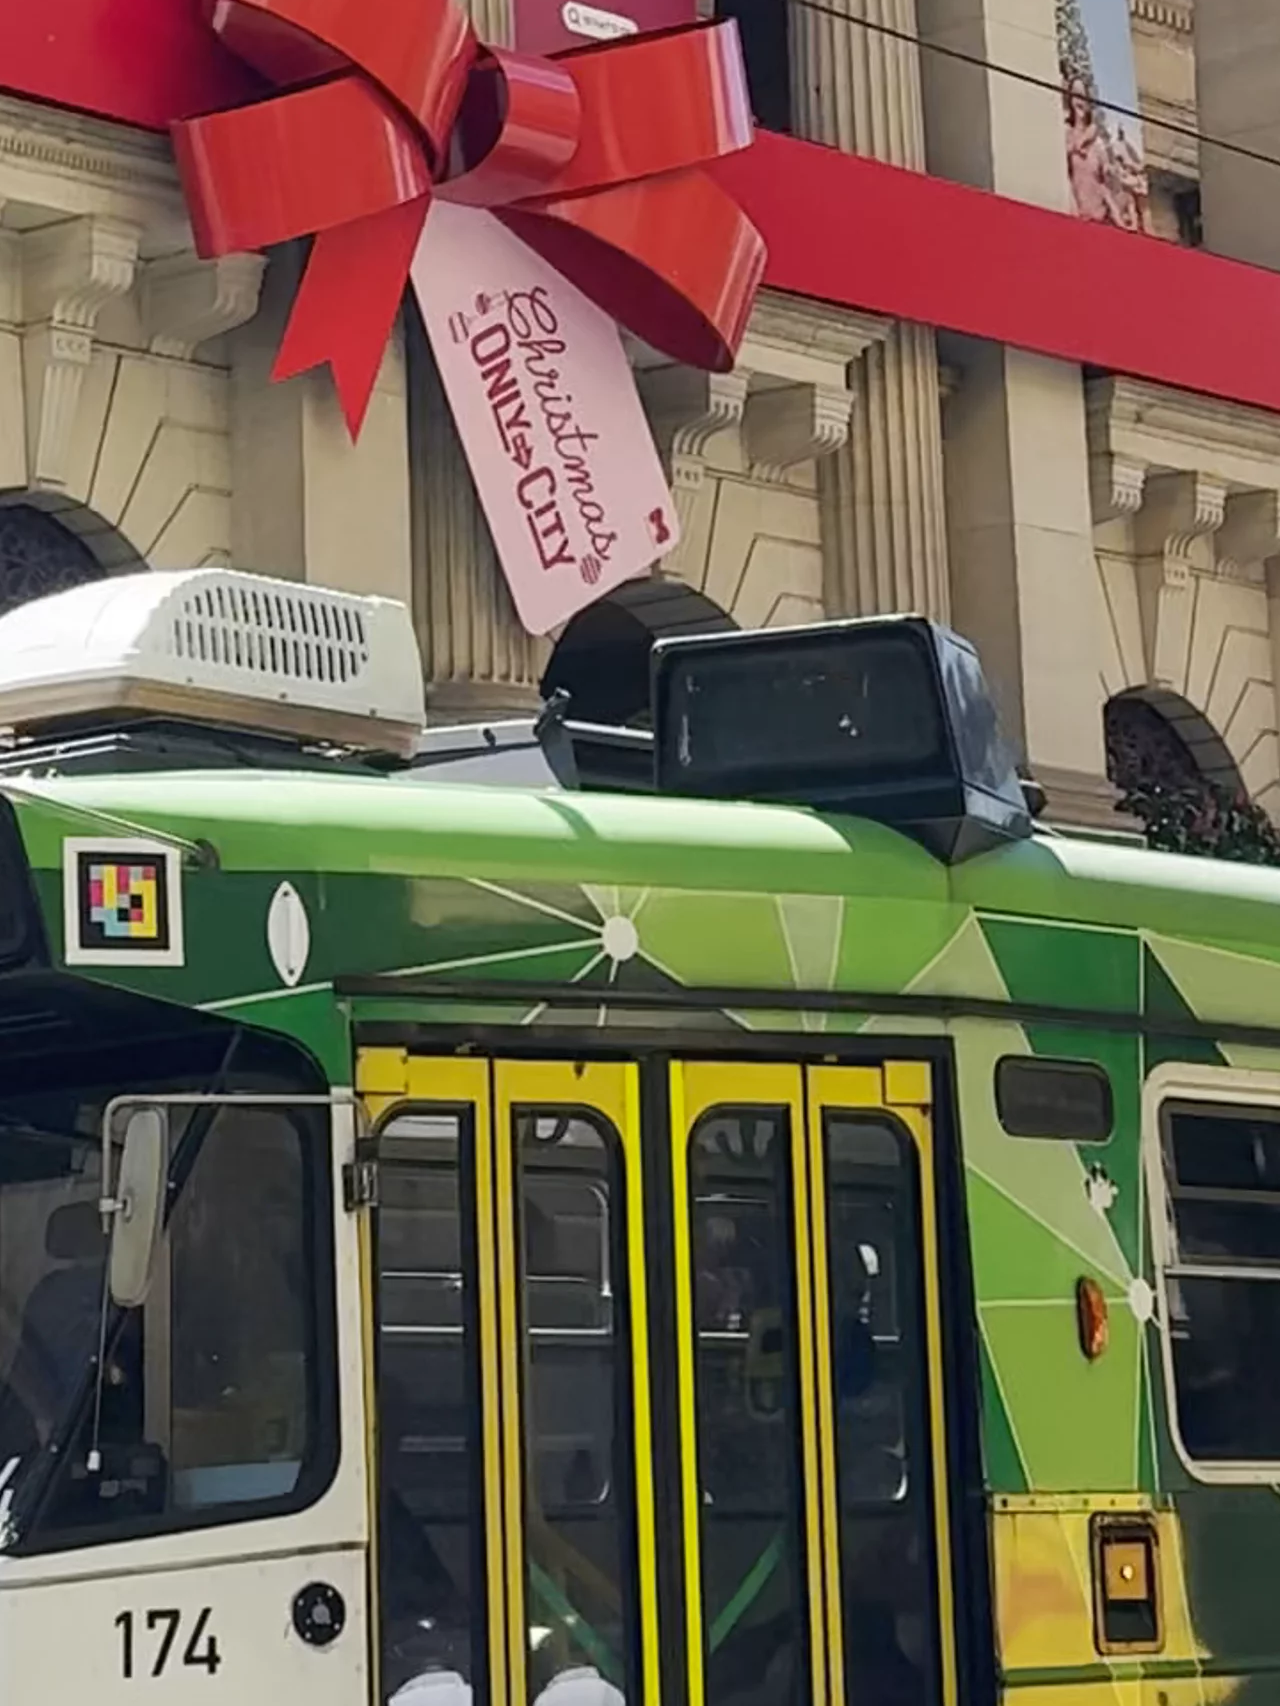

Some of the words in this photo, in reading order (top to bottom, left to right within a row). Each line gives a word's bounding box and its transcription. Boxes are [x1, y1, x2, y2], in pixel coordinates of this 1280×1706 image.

[470, 322, 533, 454] ONLY
[515, 465, 577, 572] CITY
[504, 286, 618, 562] Christmas
[114, 1606, 222, 1679] 174
